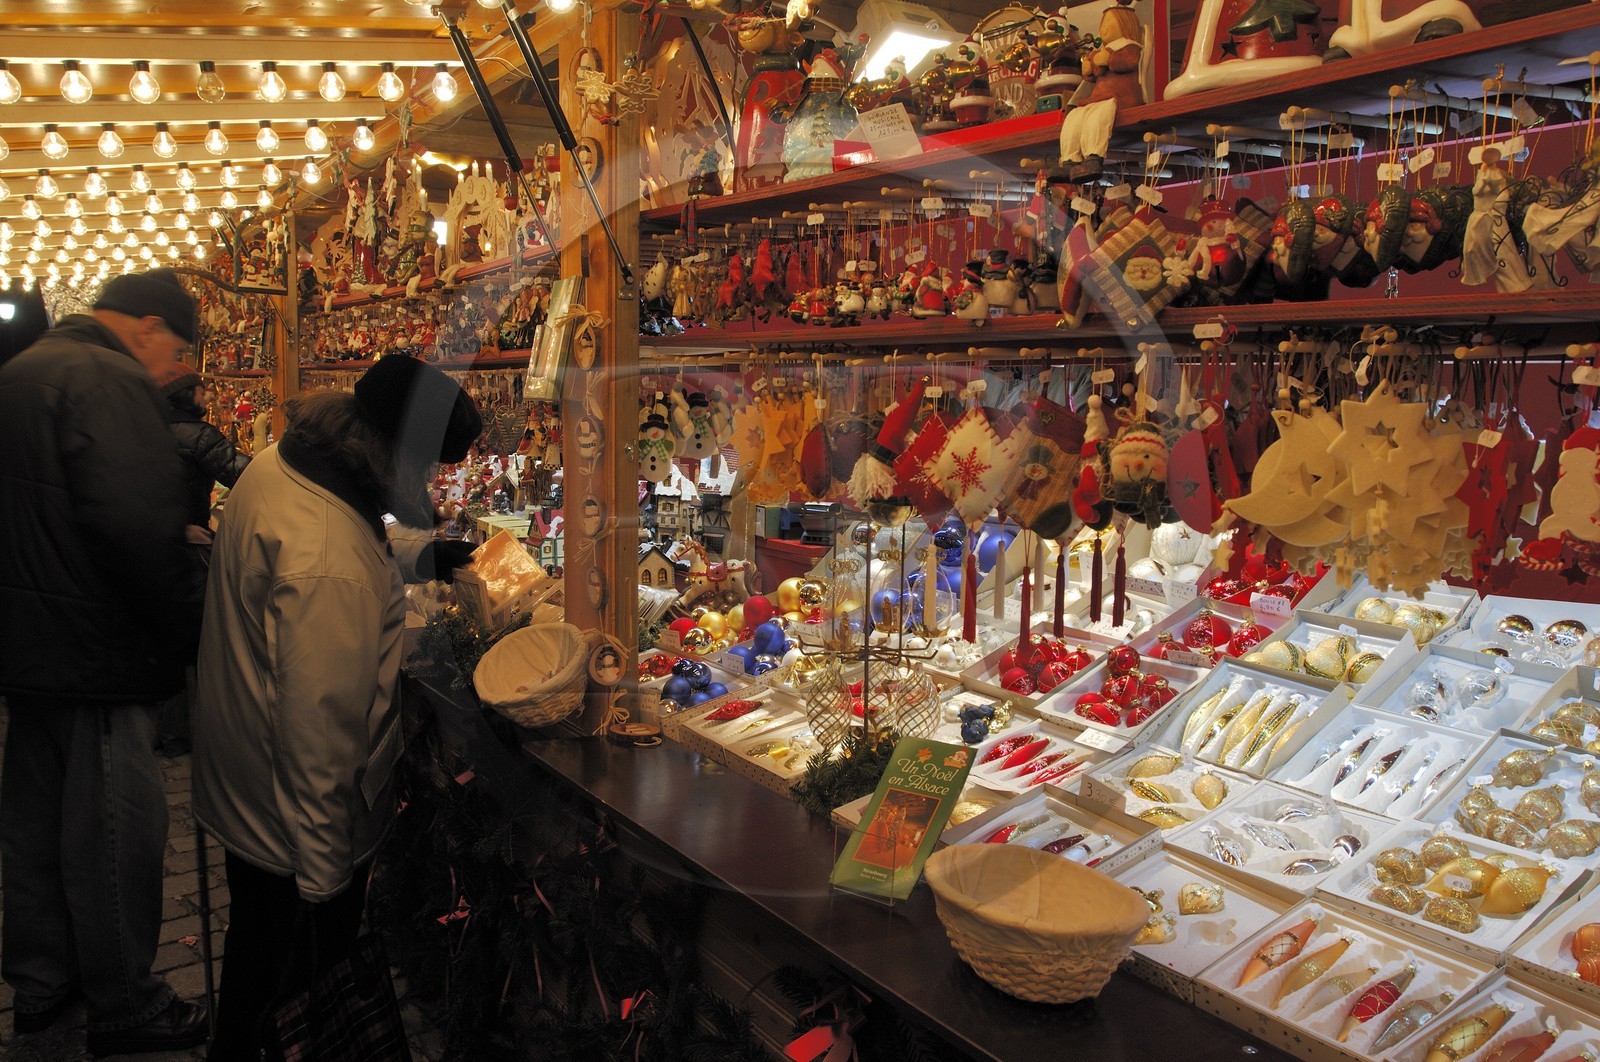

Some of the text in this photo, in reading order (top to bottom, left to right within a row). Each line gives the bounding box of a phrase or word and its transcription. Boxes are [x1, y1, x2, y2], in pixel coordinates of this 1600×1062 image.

[897, 758, 959, 782] Un Noël
[888, 774, 950, 796] en Alsace
